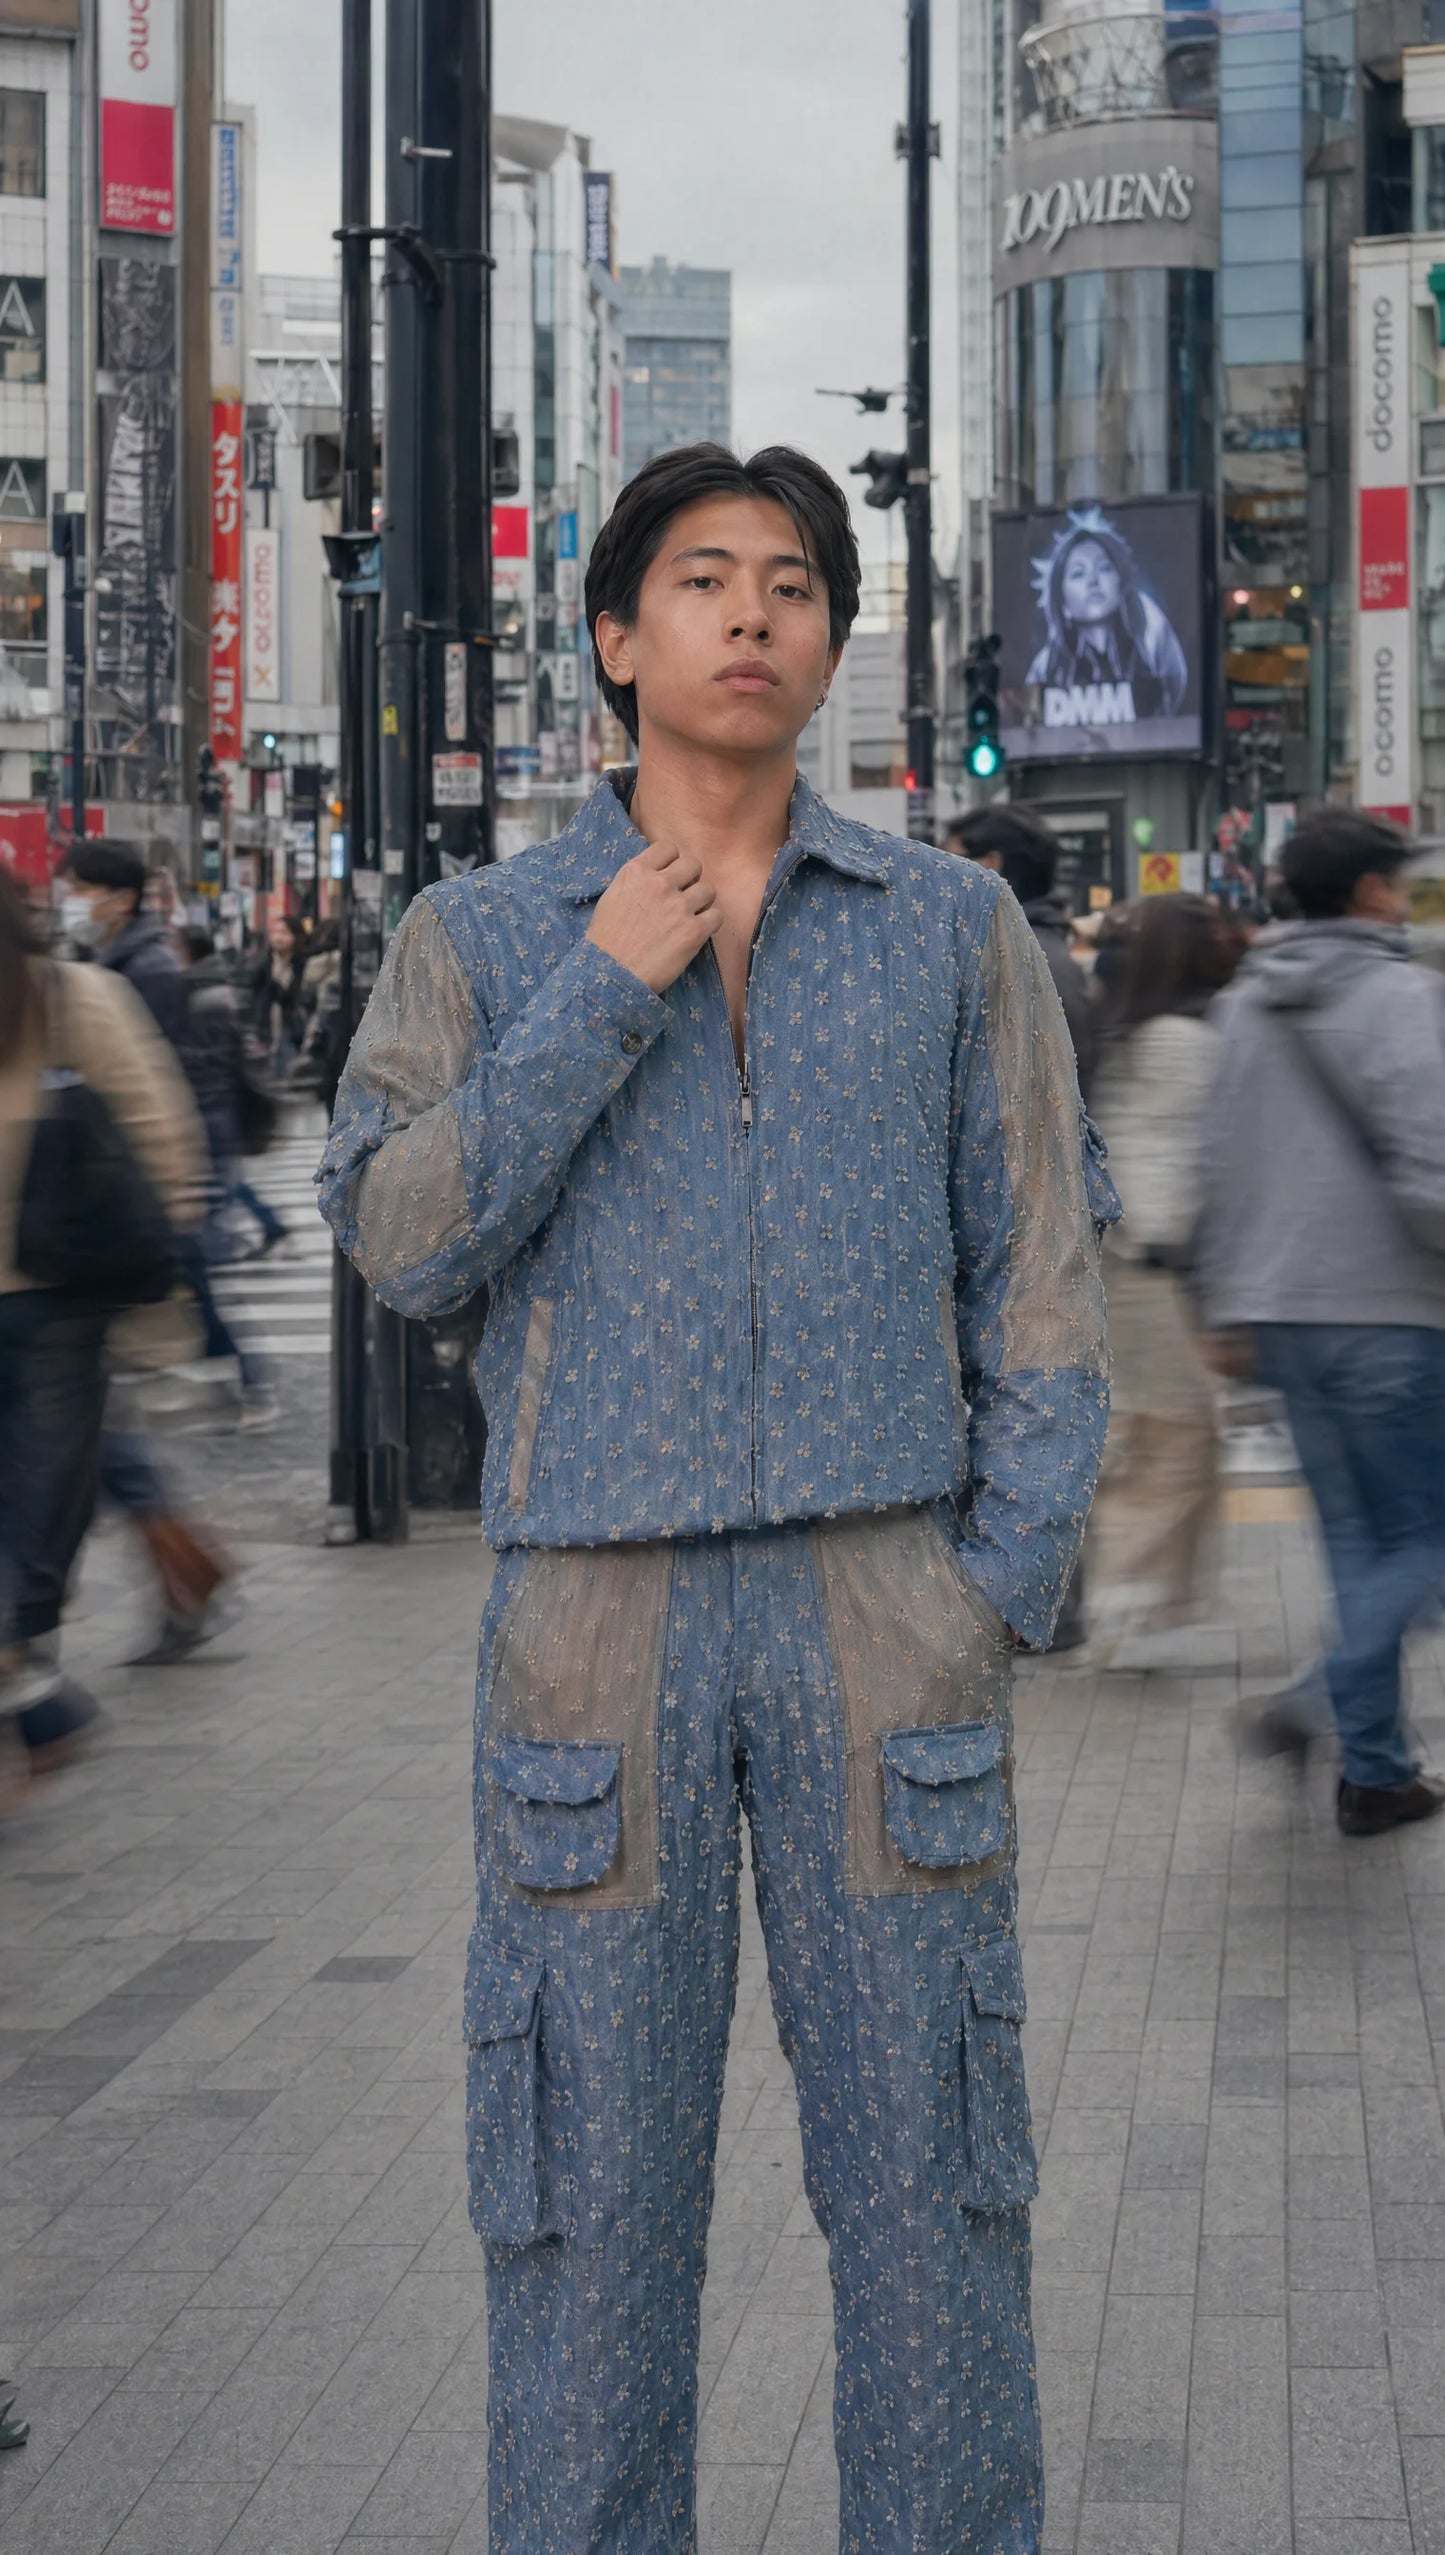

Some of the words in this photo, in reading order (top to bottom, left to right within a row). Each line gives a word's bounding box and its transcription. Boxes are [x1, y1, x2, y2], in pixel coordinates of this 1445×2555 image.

[1366, 295, 1393, 453] docomo
[1043, 681, 1136, 727] DMM
[1374, 646, 1394, 777] ocomo
